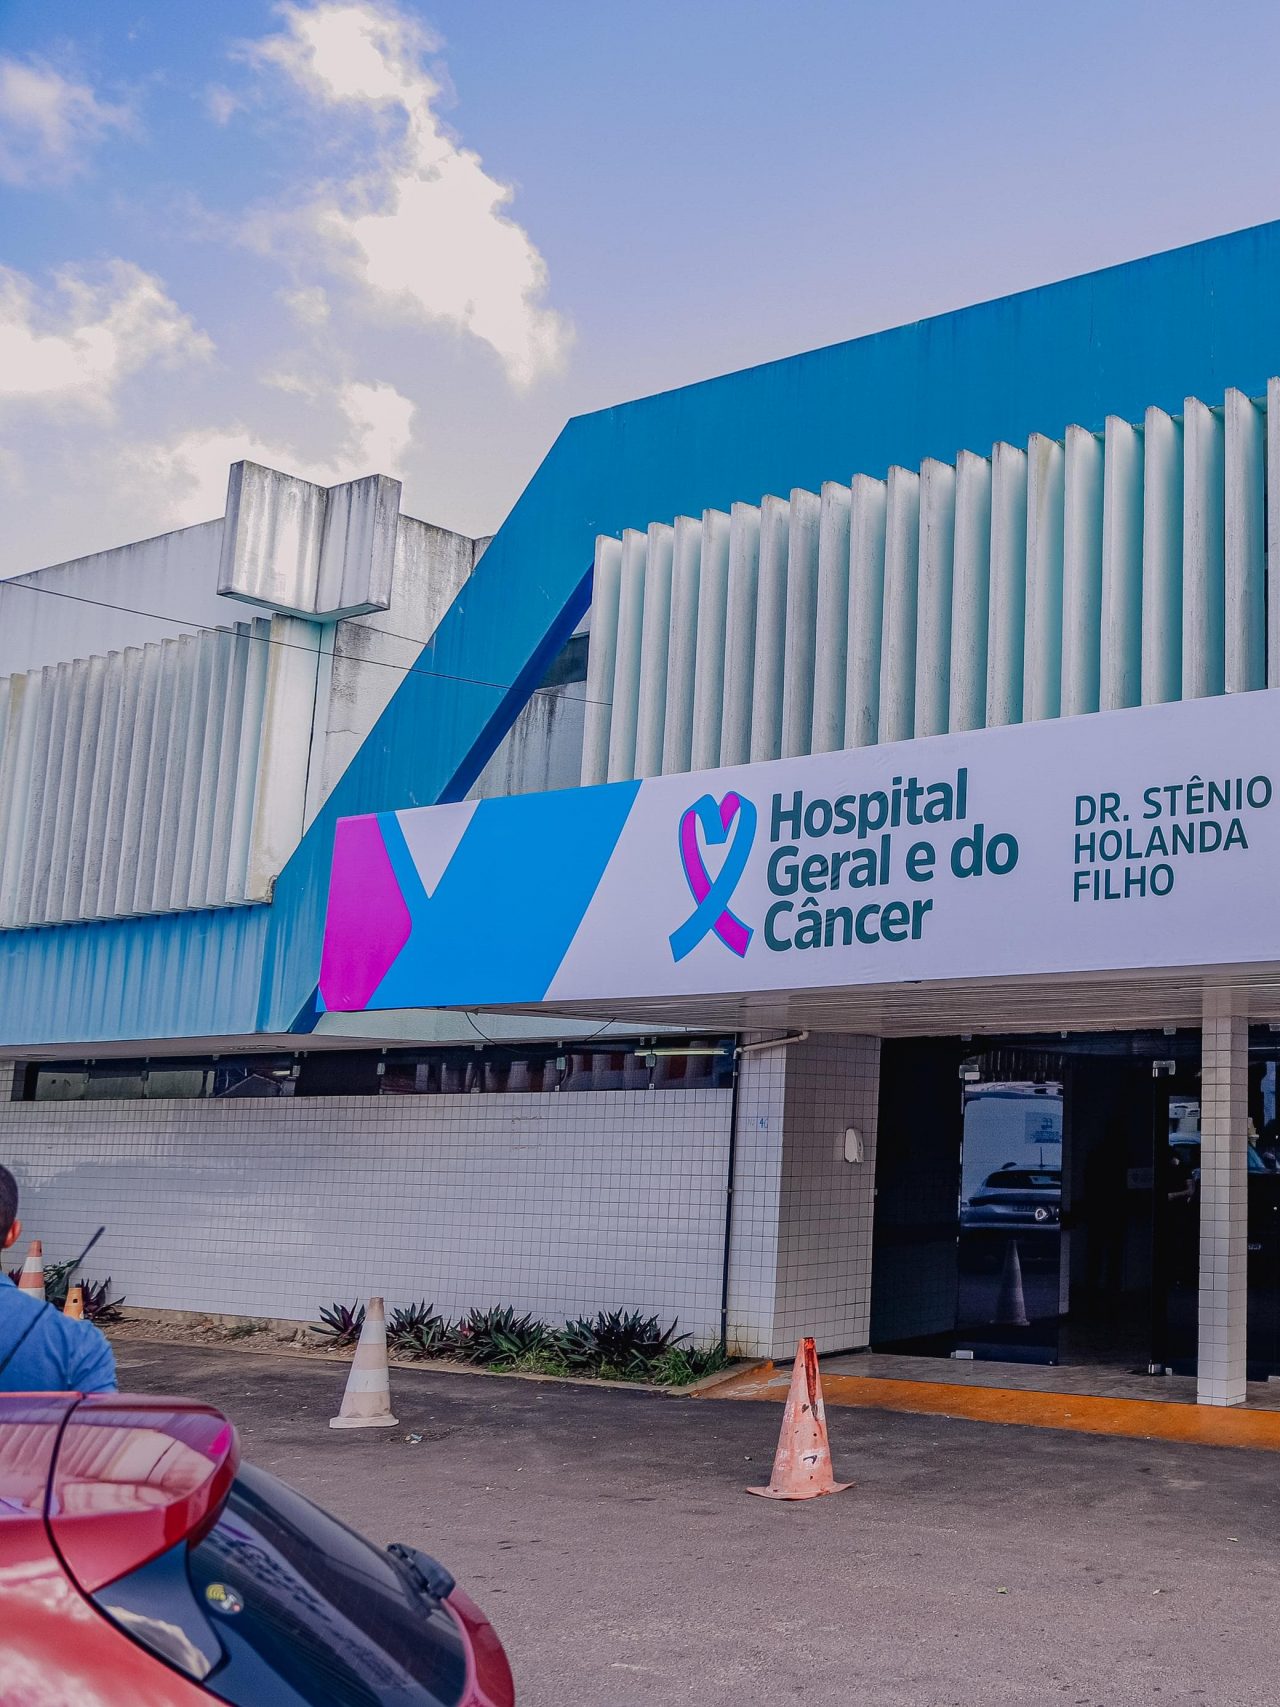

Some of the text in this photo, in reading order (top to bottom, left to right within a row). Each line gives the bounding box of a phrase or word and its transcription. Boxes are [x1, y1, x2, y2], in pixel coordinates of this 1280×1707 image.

[769, 767, 968, 843] Hospital
[1074, 774, 1273, 827] DR. STÊNIO
[766, 823, 1019, 897] Geral e do
[1073, 817, 1249, 865] HOLANDA
[1073, 863, 1175, 903] FILHO
[763, 896, 934, 952] Câncer
